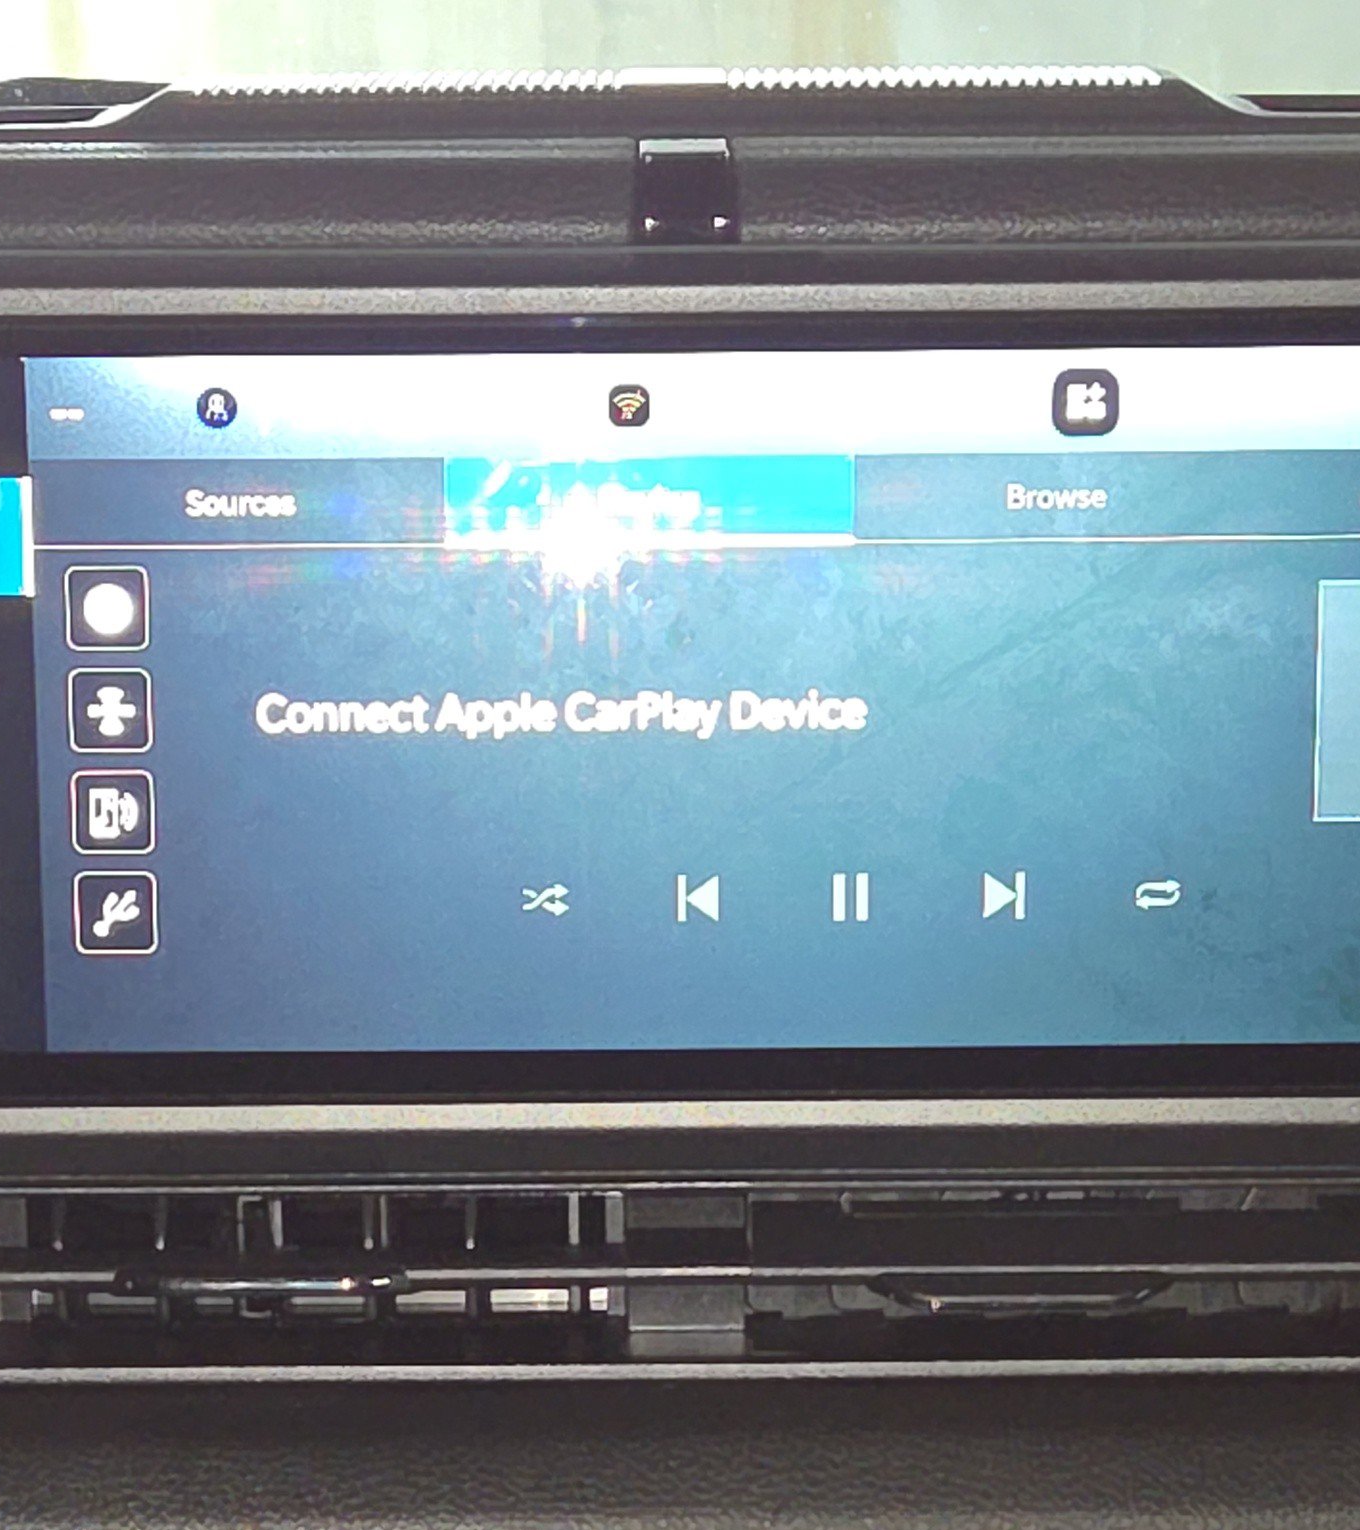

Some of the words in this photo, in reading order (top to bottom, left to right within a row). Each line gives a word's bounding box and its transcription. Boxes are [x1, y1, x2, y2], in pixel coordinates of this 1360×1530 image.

[185, 489, 297, 519] Sources
[1006, 483, 1108, 510] Browse
[255, 692, 430, 735] Connect
[435, 691, 558, 741] Apple
[563, 689, 722, 740] CarPlay
[728, 688, 869, 732] Device
